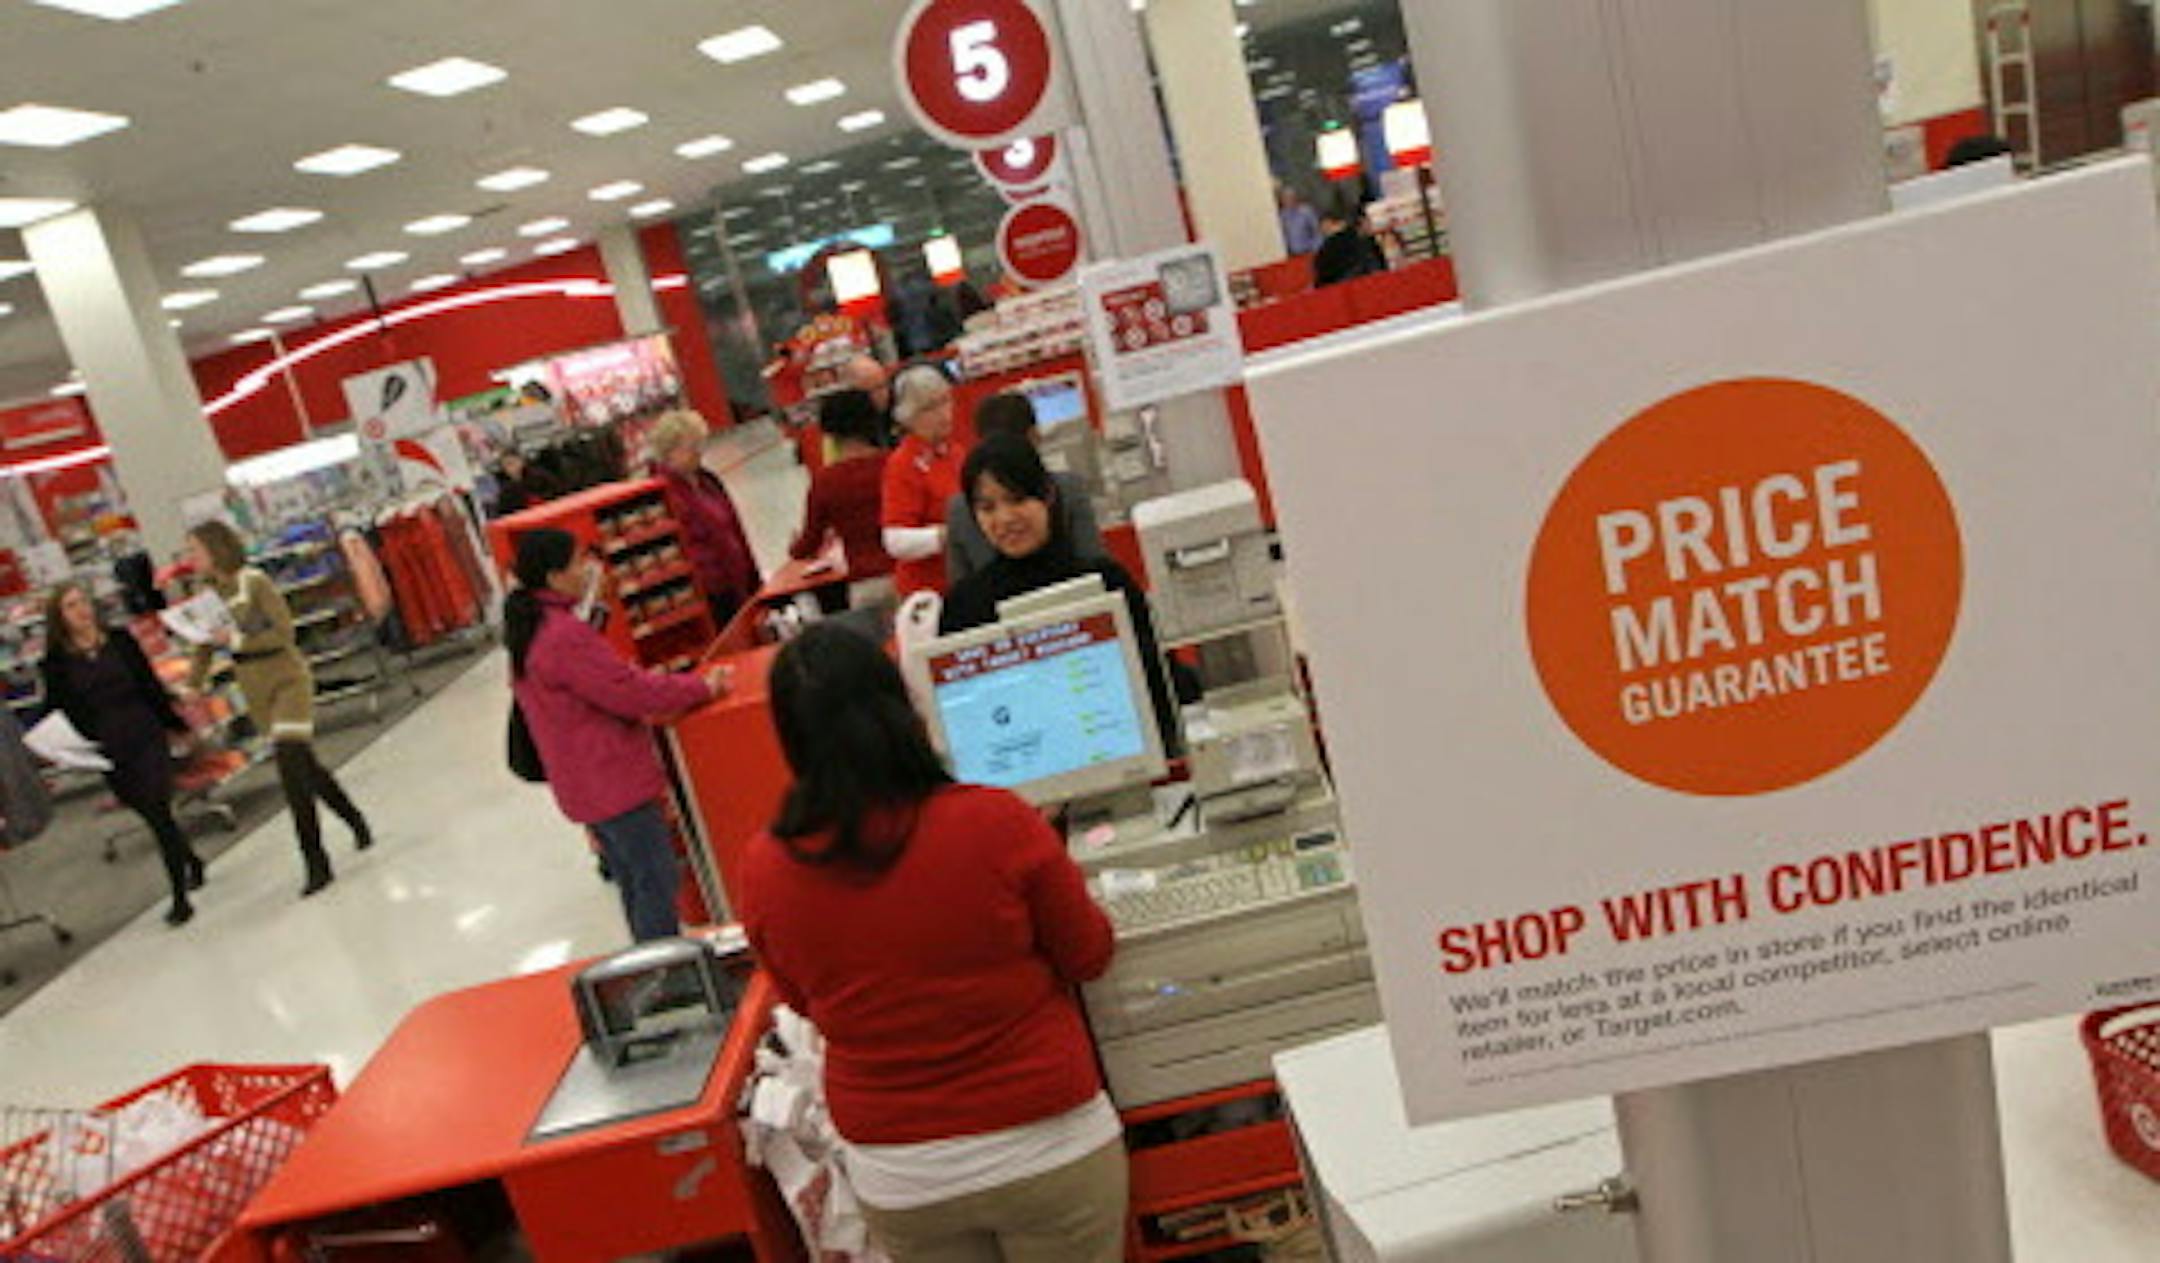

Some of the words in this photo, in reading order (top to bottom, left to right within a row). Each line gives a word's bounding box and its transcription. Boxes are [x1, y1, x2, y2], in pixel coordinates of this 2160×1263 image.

[948, 19, 1009, 102] 5
[1596, 459, 1871, 594] PRICE
[1610, 552, 1882, 672] MATCH
[1619, 632, 1891, 725] GUARANTEE
[1439, 905, 1585, 973] SHOP
[1601, 875, 1748, 941] WITH
[1769, 799, 2148, 913] CONFIDENCE.
[1450, 986, 1509, 1014] We'll
[1517, 972, 1597, 999] match
[1605, 966, 1645, 987] the
[1652, 953, 1718, 981] price
[1726, 946, 1749, 964] in
[1757, 932, 1826, 960] store
[1833, 923, 1849, 945] if
[1856, 918, 1905, 947] you
[1913, 904, 1962, 931] find
[1972, 899, 2015, 920] the
[2023, 871, 2138, 911] identical
[1458, 1017, 1509, 1038] item
[1517, 1008, 1551, 1027] for
[1557, 999, 1611, 1019] less
[1618, 990, 1641, 1010] at
[1651, 987, 1667, 1005] a
[1672, 971, 1735, 1000] local
[1900, 927, 1981, 960] select
[1987, 913, 2070, 943] online
[1462, 1035, 1554, 1062] retailer,
[1562, 1026, 1586, 1046] or
